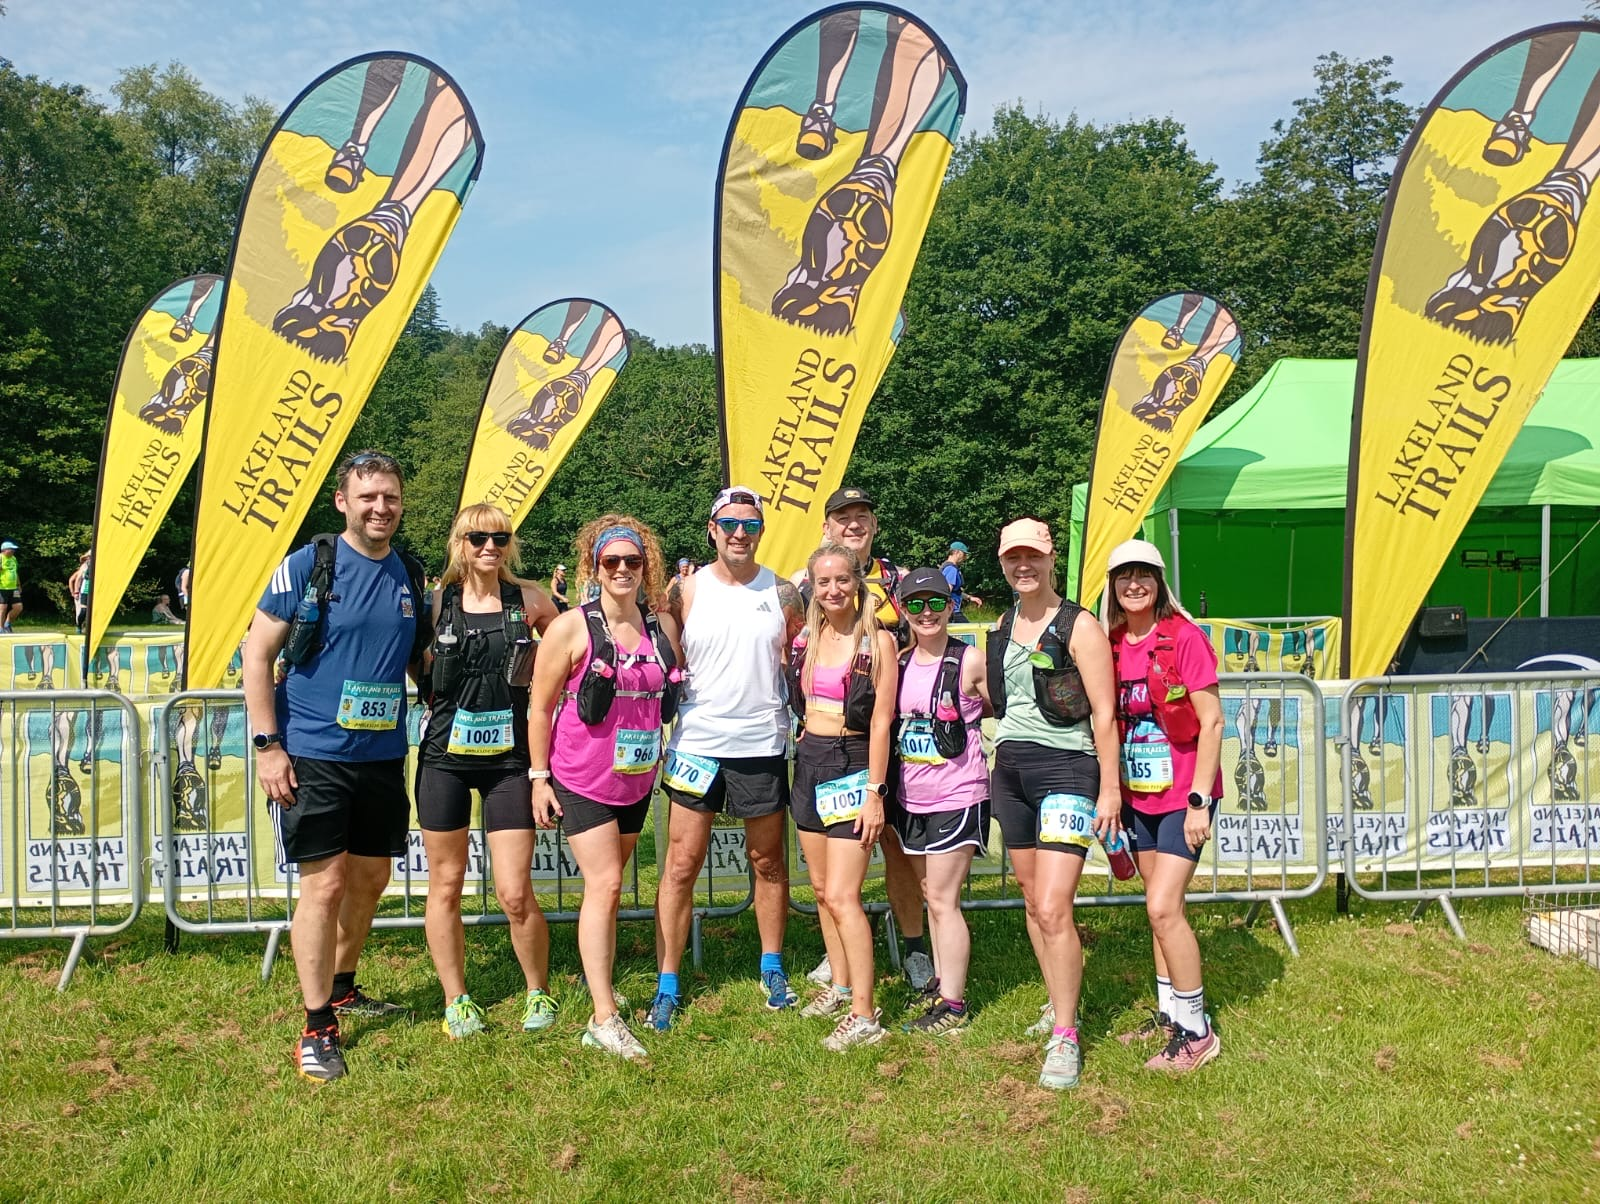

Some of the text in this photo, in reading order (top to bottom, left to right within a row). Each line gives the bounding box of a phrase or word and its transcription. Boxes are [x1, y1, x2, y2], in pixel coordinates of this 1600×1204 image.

[221, 369, 312, 518] LAKELAND
[241, 382, 343, 533] TRAILS
[759, 348, 822, 506] LAKELAND
[774, 357, 857, 514] TRAILS
[1375, 353, 1474, 508] LAKELAND
[1398, 366, 1512, 522] TRAILS
[110, 439, 163, 524] LAKELAND
[122, 446, 181, 531] TRAILS
[503, 459, 545, 518] AILS
[1103, 434, 1154, 507] LAKELAND
[1114, 441, 1171, 515] TRAILS
[360, 700, 387, 717] 853
[466, 728, 500, 744] 1002
[904, 737, 931, 753] 1017
[633, 747, 654, 763] 966
[670, 758, 700, 783] 1170
[832, 788, 863, 811] 1007
[1059, 812, 1085, 832] 980
